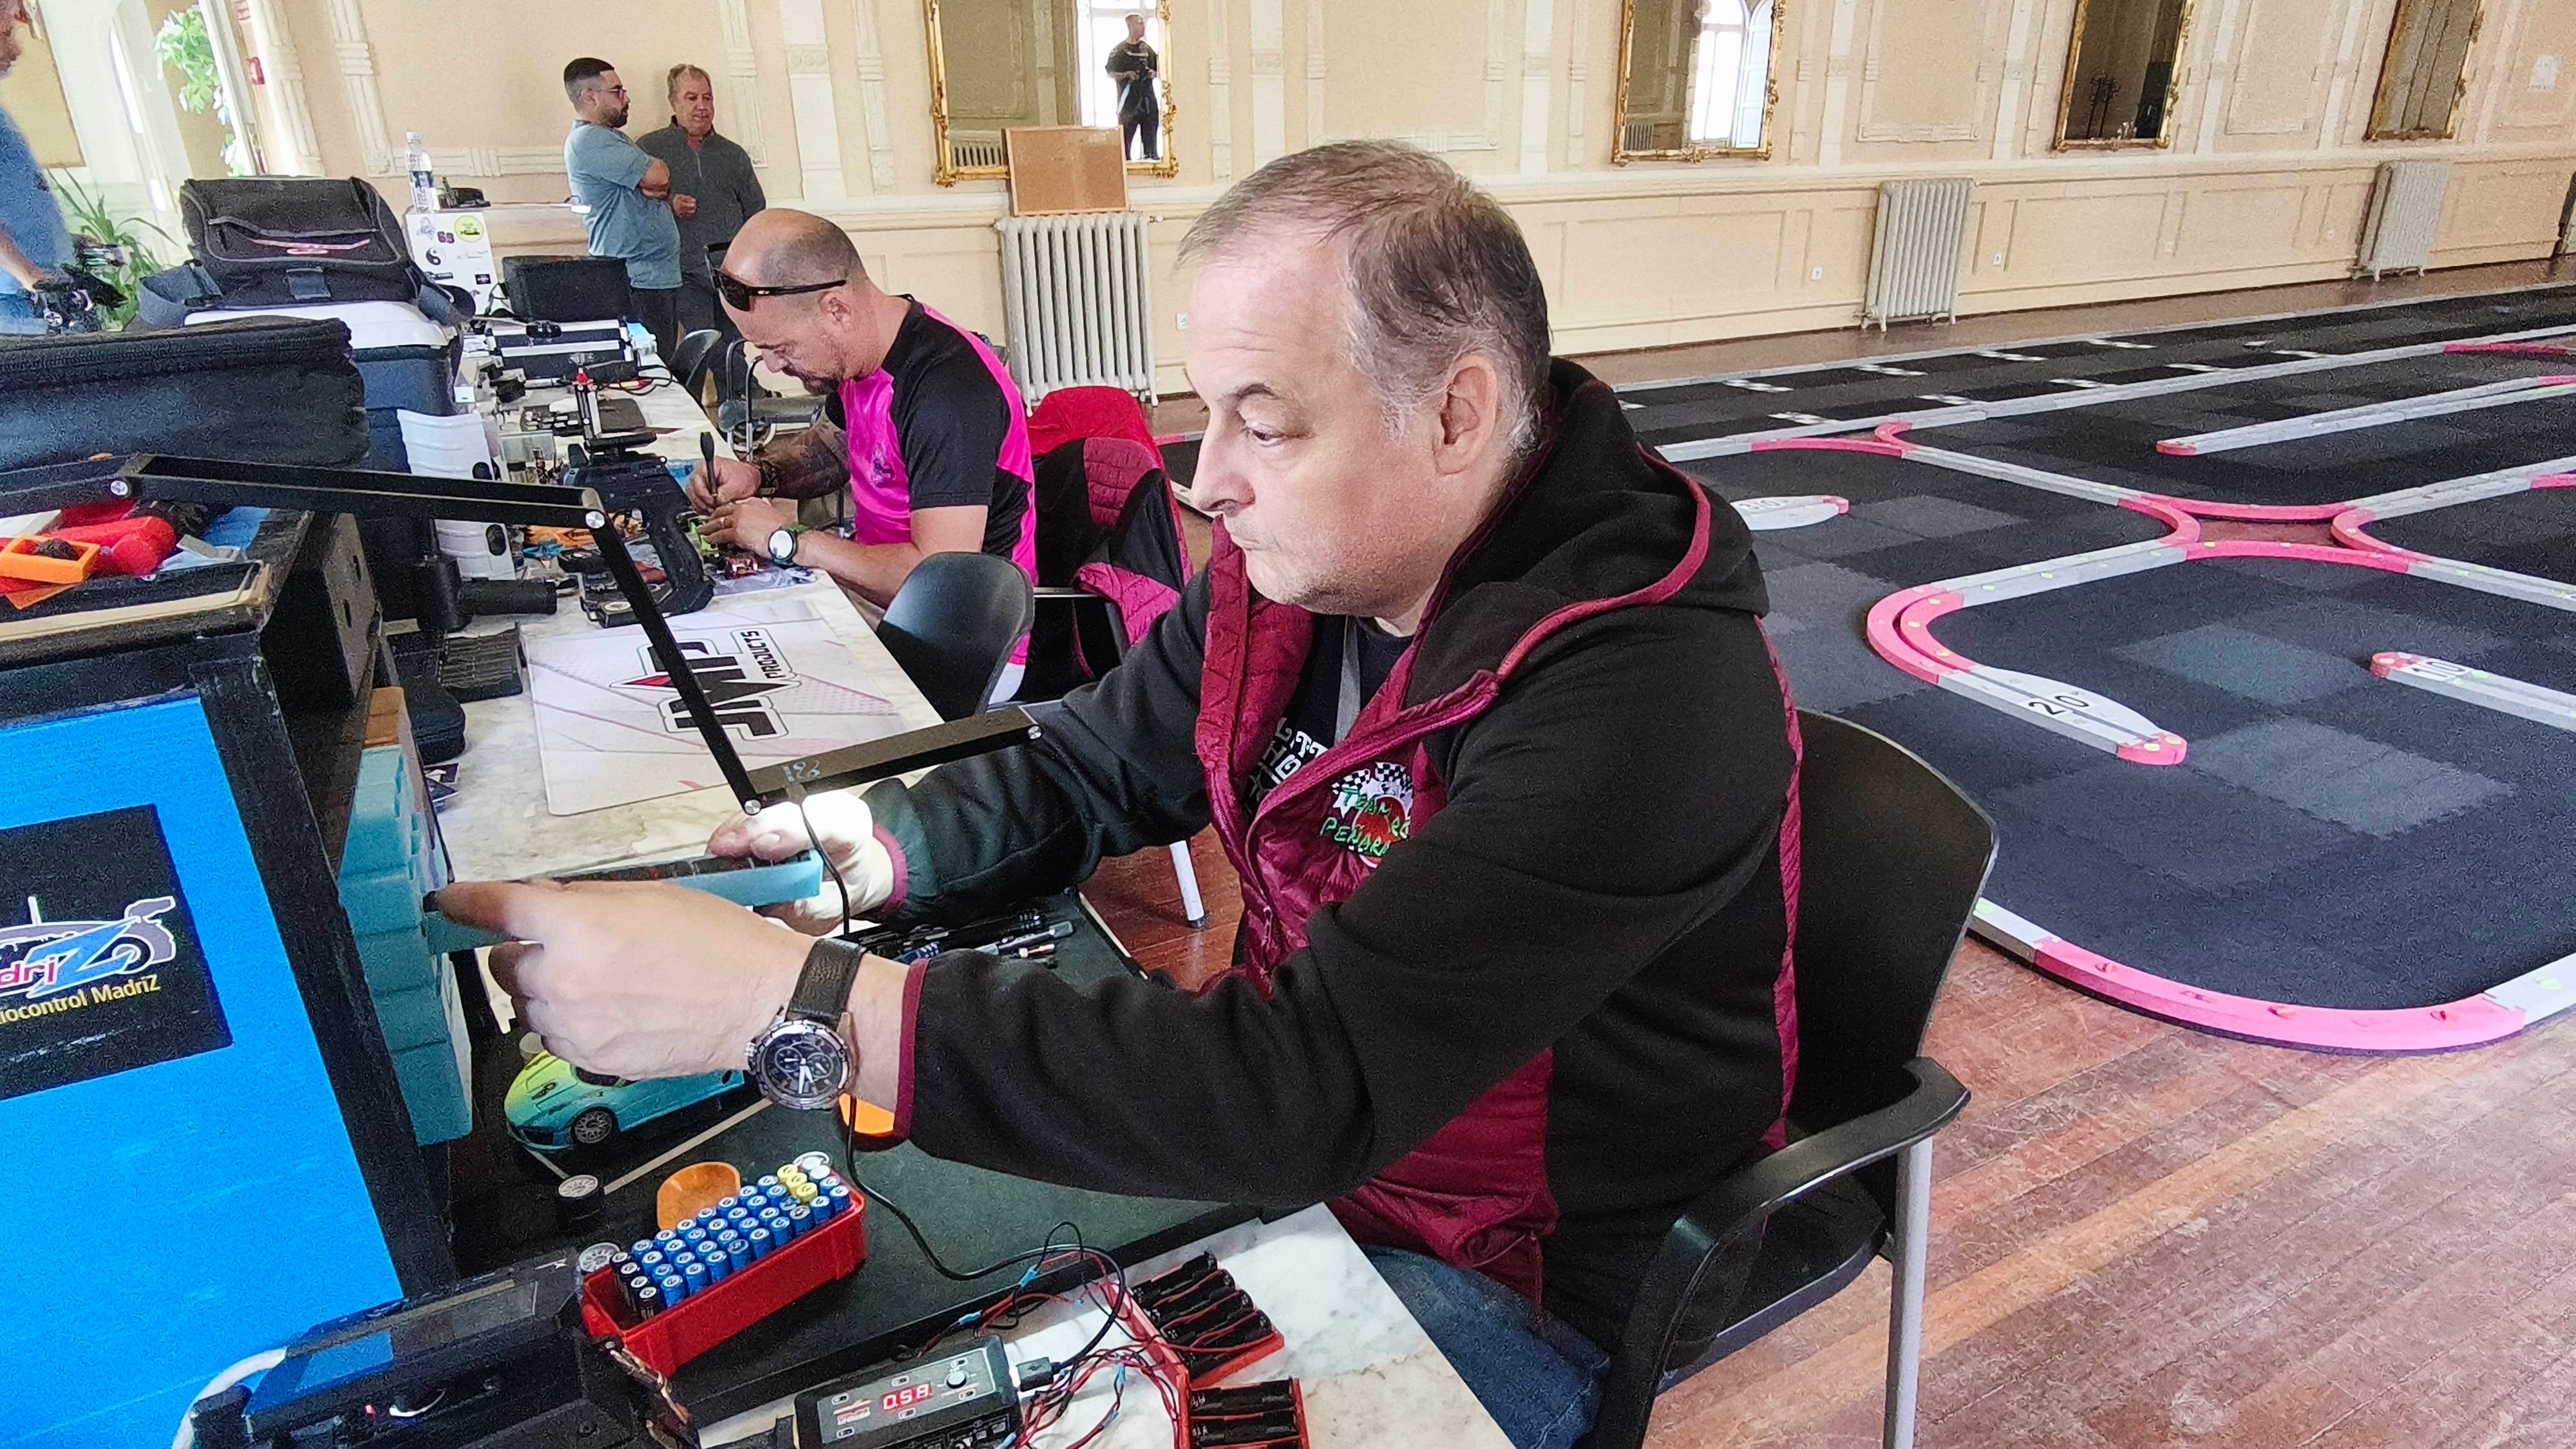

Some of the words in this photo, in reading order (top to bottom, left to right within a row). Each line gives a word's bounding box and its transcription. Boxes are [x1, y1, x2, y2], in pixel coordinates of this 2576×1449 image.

[741, 630, 787, 679] PRODUCTS
[2410, 661, 2466, 678] 10
[2028, 695, 2090, 716] 20
[0, 989, 88, 1025] iocontrol
[90, 974, 161, 1004] MadriZ
